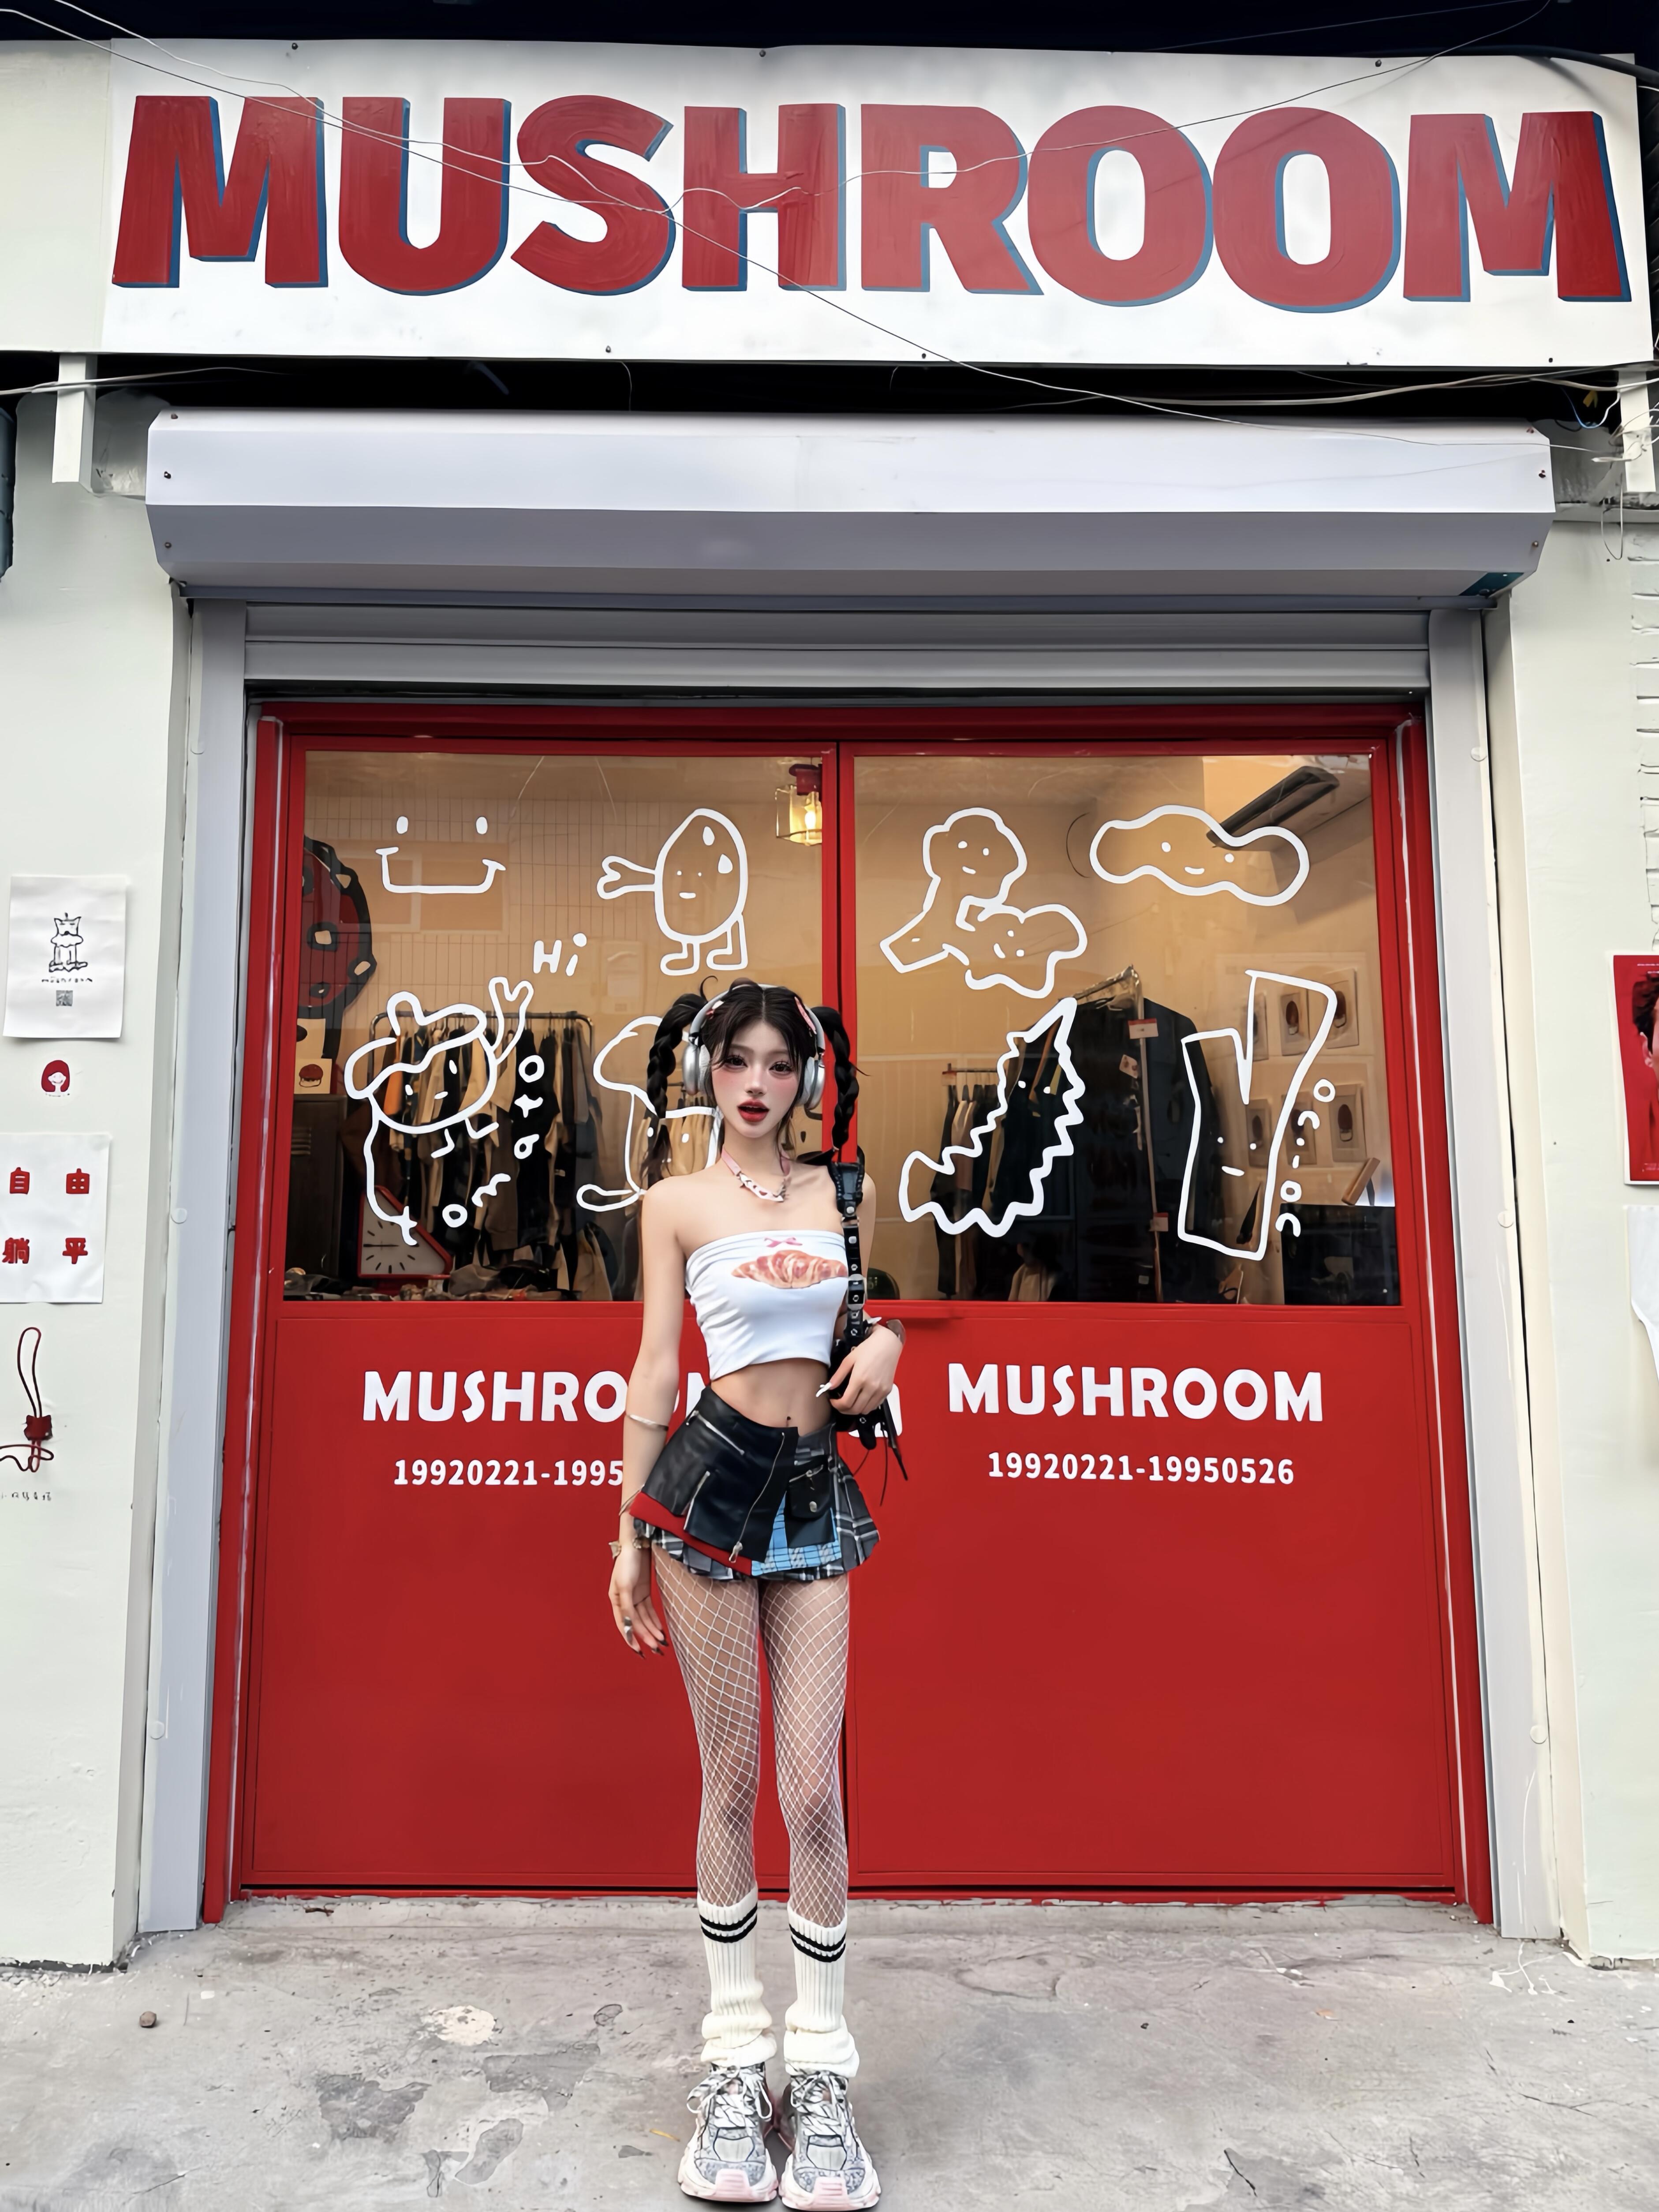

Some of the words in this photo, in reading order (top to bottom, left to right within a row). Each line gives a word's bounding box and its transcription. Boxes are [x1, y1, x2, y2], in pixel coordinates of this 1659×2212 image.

[113, 95, 1631, 314] MUSHROOM
[533, 932, 587, 976] Hi
[9, 1167, 90, 1194] 自由
[2, 1237, 88, 1265] 躺平
[362, 1370, 707, 1423] MUSHRO
[948, 1363, 1323, 1422] MUSHROOM
[394, 1459, 623, 1486] 19920221-1995
[988, 1452, 1294, 1485] 19920221-19950526
